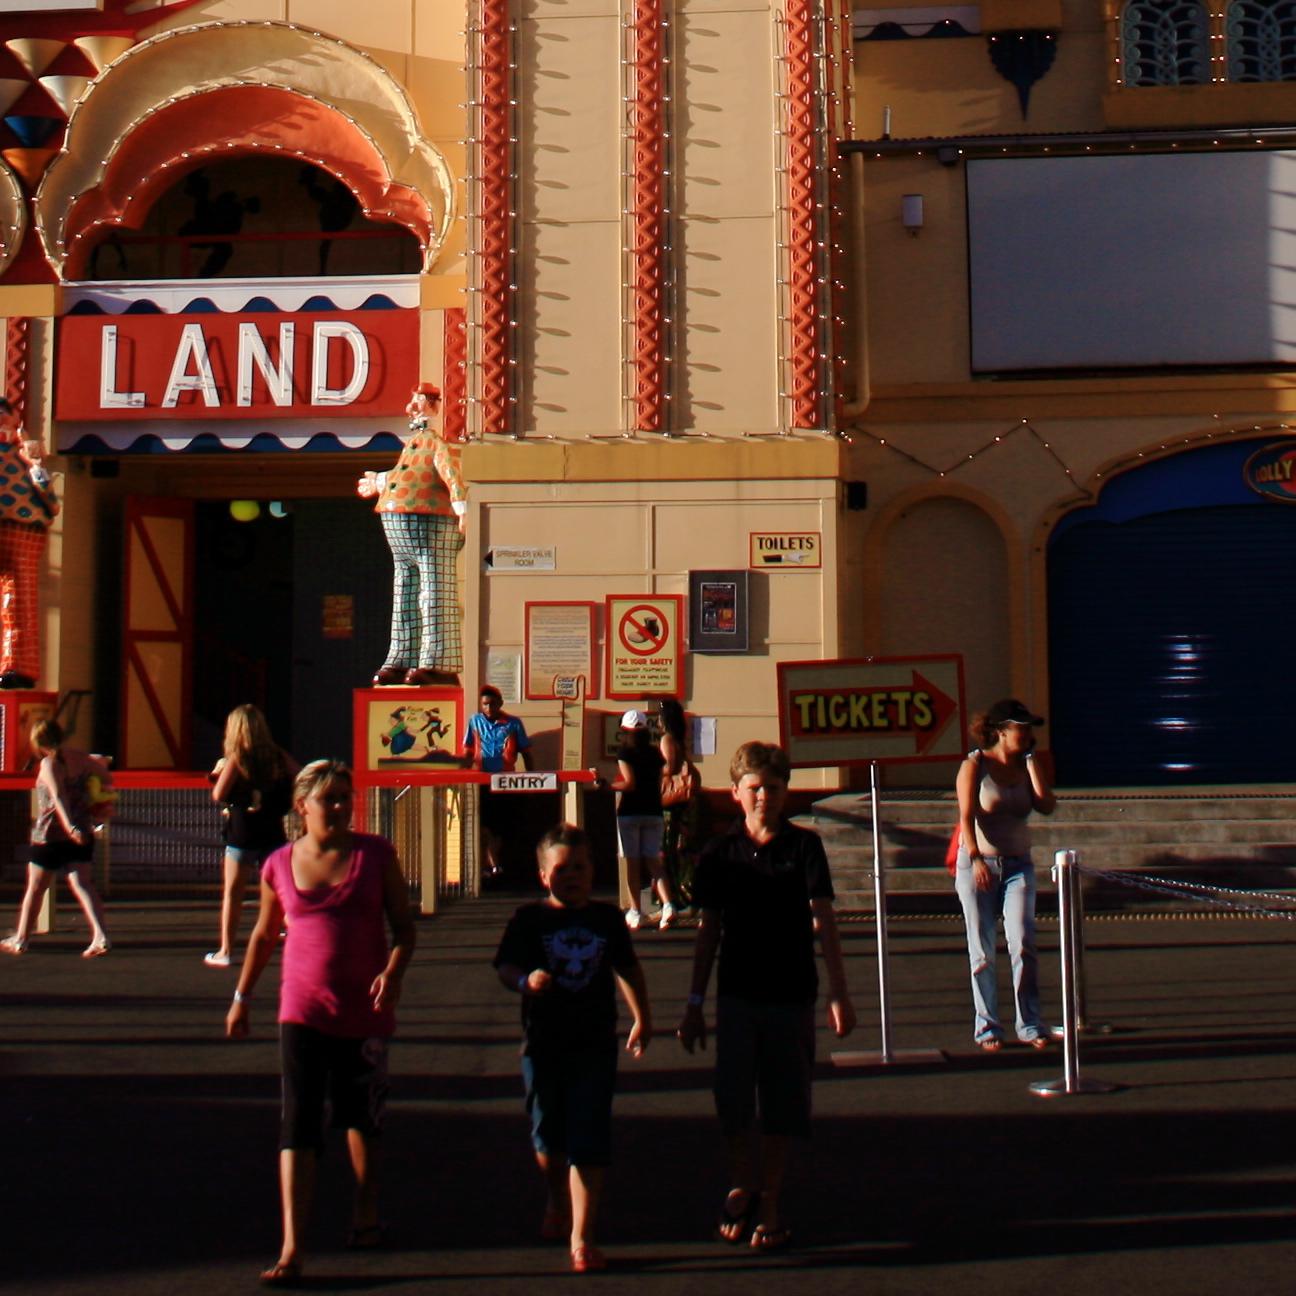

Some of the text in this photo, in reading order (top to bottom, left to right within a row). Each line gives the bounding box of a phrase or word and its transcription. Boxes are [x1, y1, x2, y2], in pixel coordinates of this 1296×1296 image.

[100, 320, 371, 409] LAND
[757, 536, 814, 550] TOILETS
[514, 559, 534, 567] ROOM
[794, 690, 936, 732] TICKETS
[498, 776, 548, 789] ENTRY
